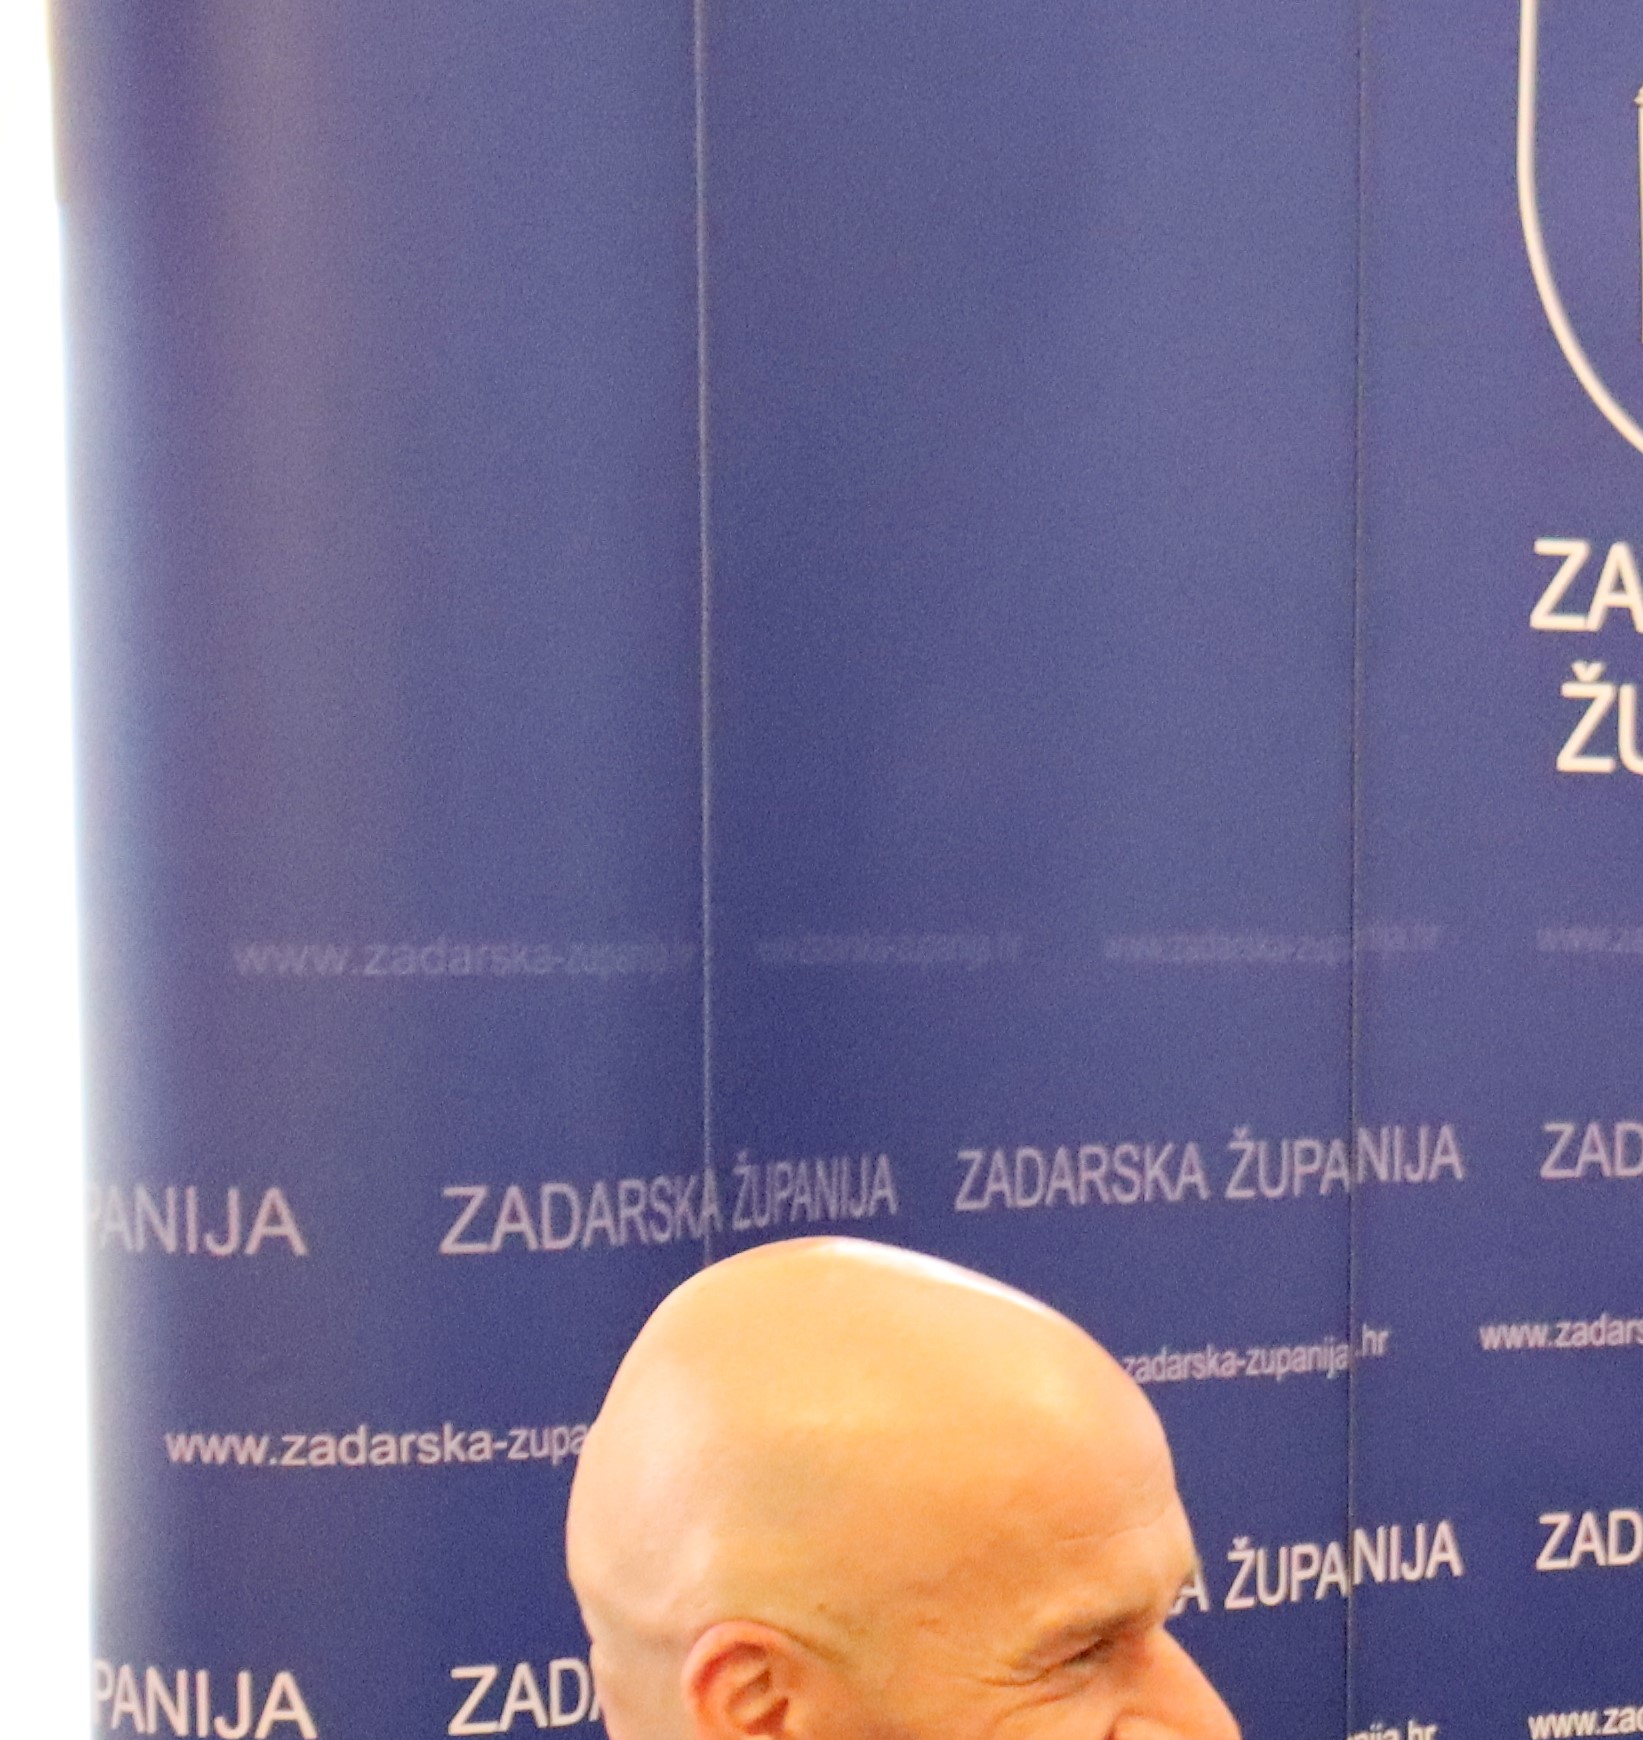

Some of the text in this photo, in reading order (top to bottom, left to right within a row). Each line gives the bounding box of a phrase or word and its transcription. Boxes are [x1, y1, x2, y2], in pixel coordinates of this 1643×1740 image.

[439, 1150, 899, 1255] ZADARSKA ŽUPANIJA
[955, 1122, 1464, 1212] ZADARSKA ŽUPANIJA
[1224, 1519, 1464, 1611] ŽUPANIJA
[448, 1657, 600, 1735] ZAD
